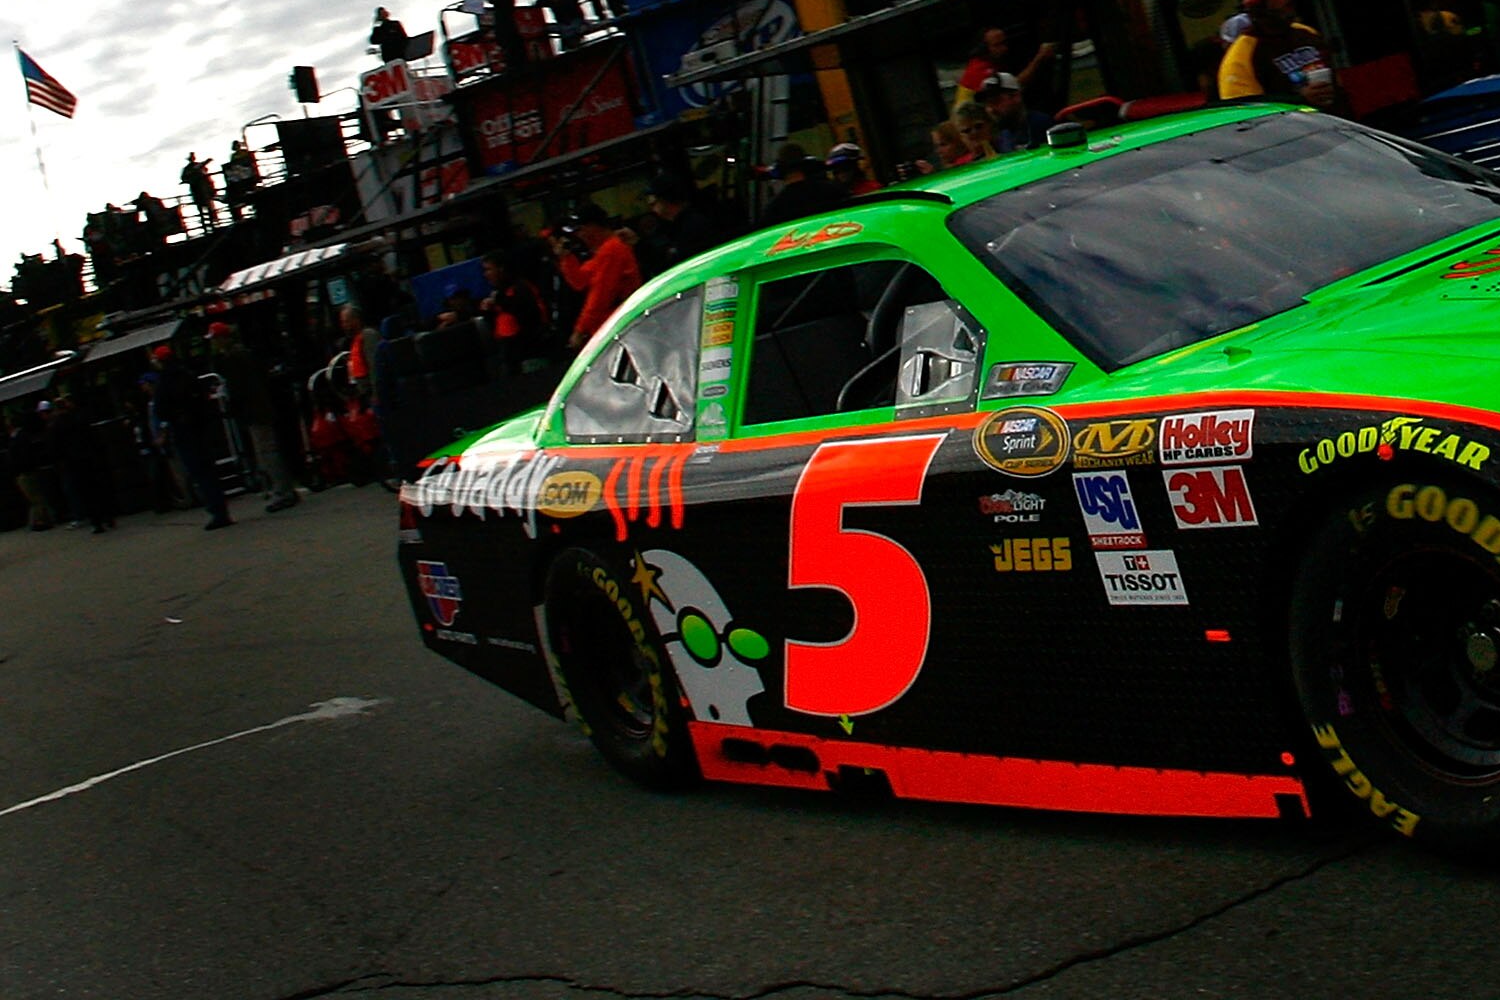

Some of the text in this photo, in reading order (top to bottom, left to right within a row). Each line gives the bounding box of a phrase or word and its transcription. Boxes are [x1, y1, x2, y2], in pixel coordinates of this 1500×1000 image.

[364, 65, 408, 103] 3M
[1014, 366, 1056, 380] NASCAR
[1000, 417, 1040, 434] NASCAR
[1003, 434, 1036, 454] Sprint
[1163, 415, 1250, 456] Holley
[1124, 450, 1156, 466] WEAR
[1163, 446, 1234, 461] HP CARBS
[1013, 499, 1046, 511] LIGHT
[1075, 475, 1139, 530] USG
[1169, 469, 1255, 525] 3M
[994, 514, 1040, 523] POLE
[1091, 535, 1143, 546] SHEETROCK
[994, 537, 1073, 572] JEGS
[784, 432, 948, 717] 5
[1105, 573, 1178, 592] TISSOT
[1311, 722, 1423, 839] EAGLE
